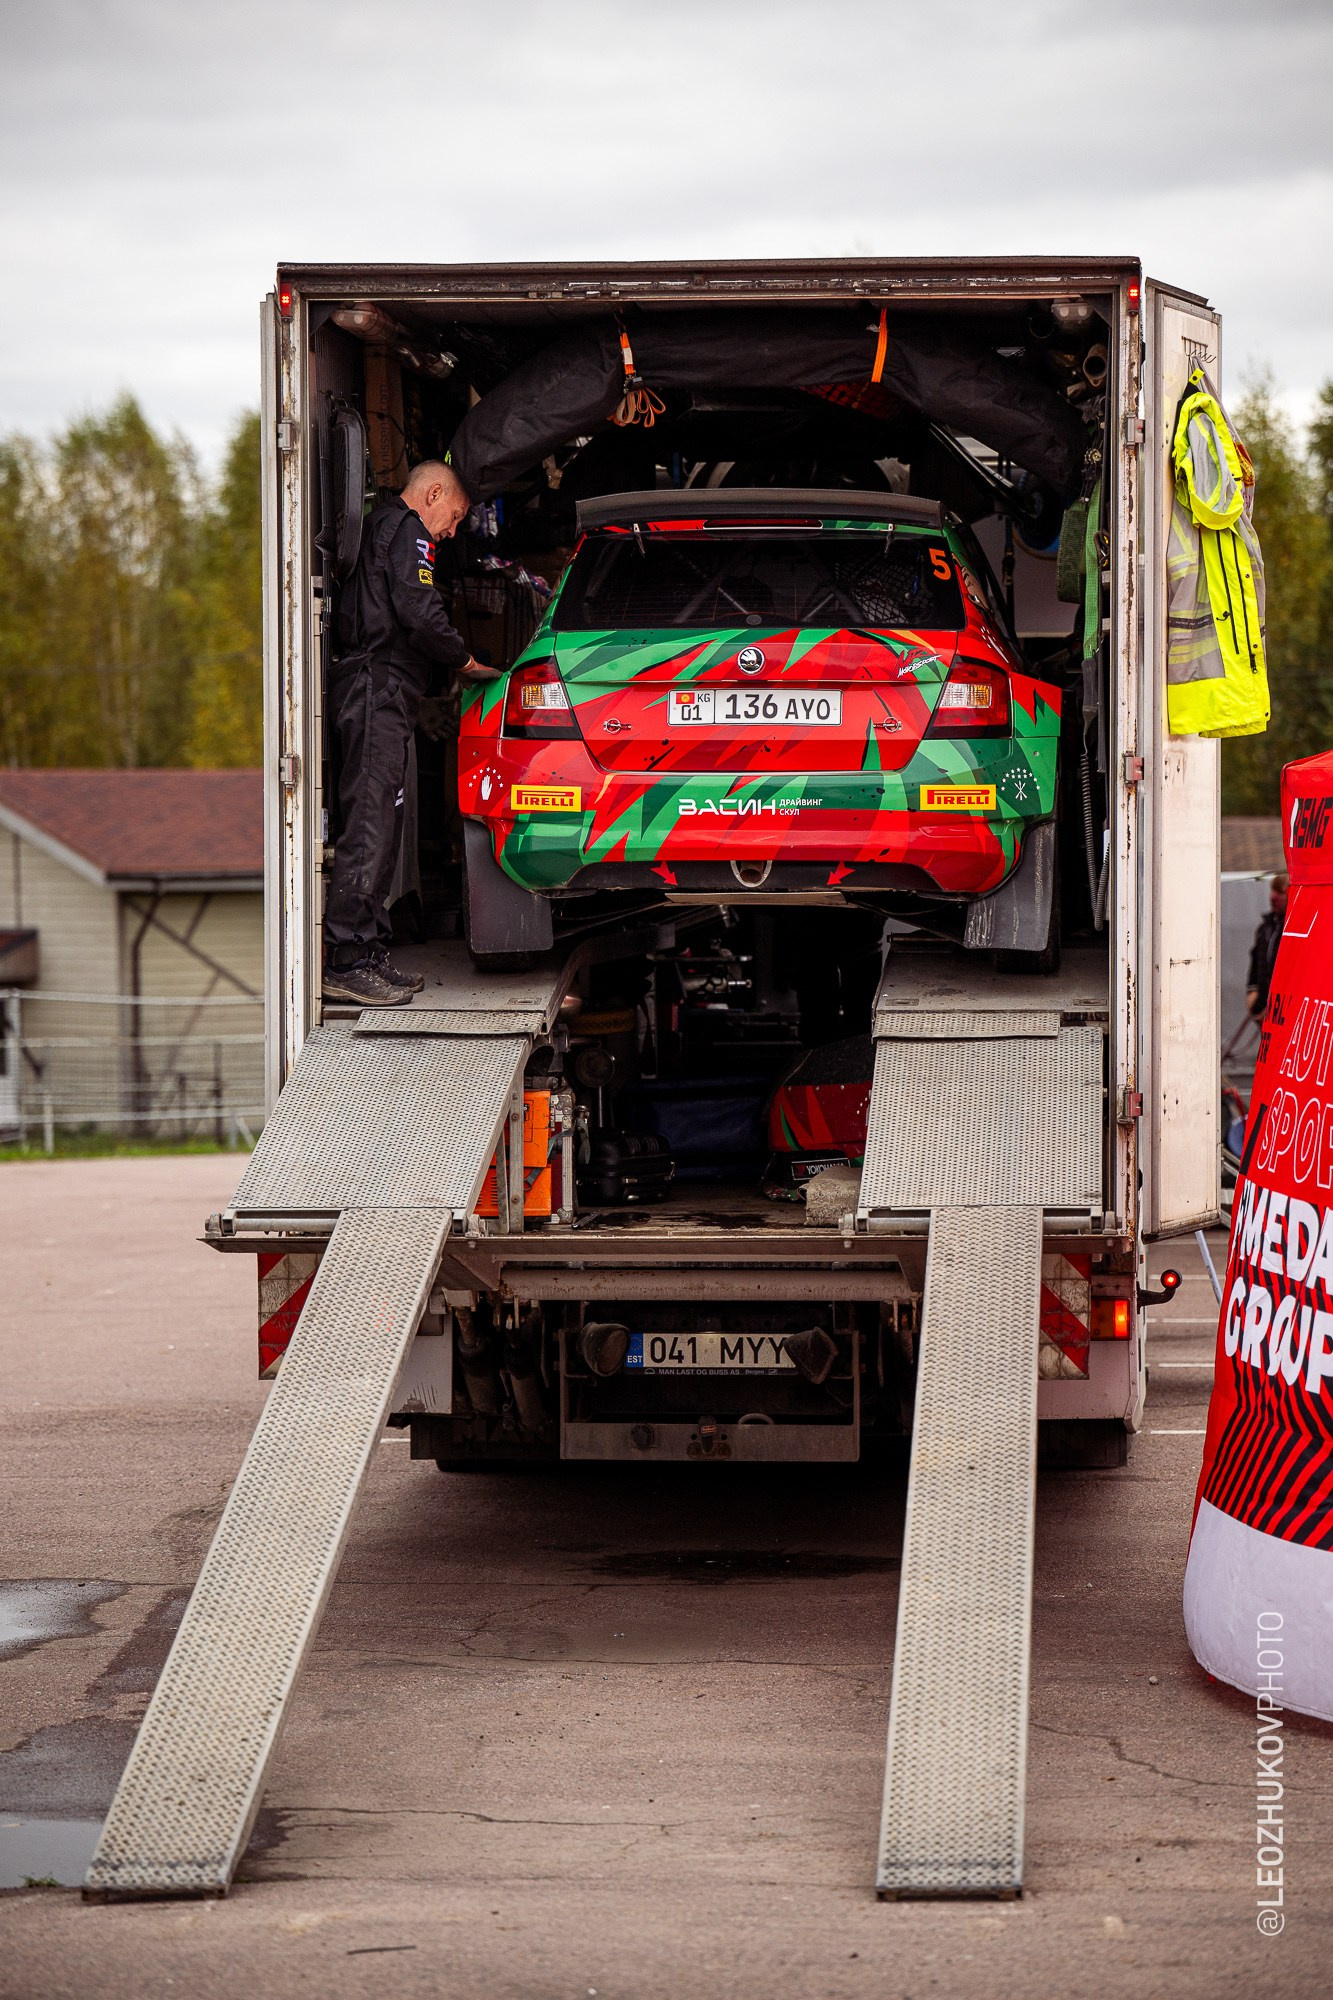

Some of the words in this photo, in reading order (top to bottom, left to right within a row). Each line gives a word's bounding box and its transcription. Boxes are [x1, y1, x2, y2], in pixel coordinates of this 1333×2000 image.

[929, 548, 951, 580] 5
[697, 693, 711, 703] KG
[681, 705, 702, 721] 01
[725, 694, 778, 719] 136
[785, 698, 831, 720] AYO
[516, 790, 575, 806] PIRELLI
[779, 798, 823, 807] ДРАЙВИНГ
[927, 789, 990, 805] PIRELLI
[678, 798, 776, 816] ВАСИН
[779, 808, 800, 816] СКУЛ
[806, 1162, 844, 1175] YOKO
[650, 1337, 697, 1364] 041
[720, 1337, 788, 1364] MYY
[627, 1355, 643, 1363] EST
